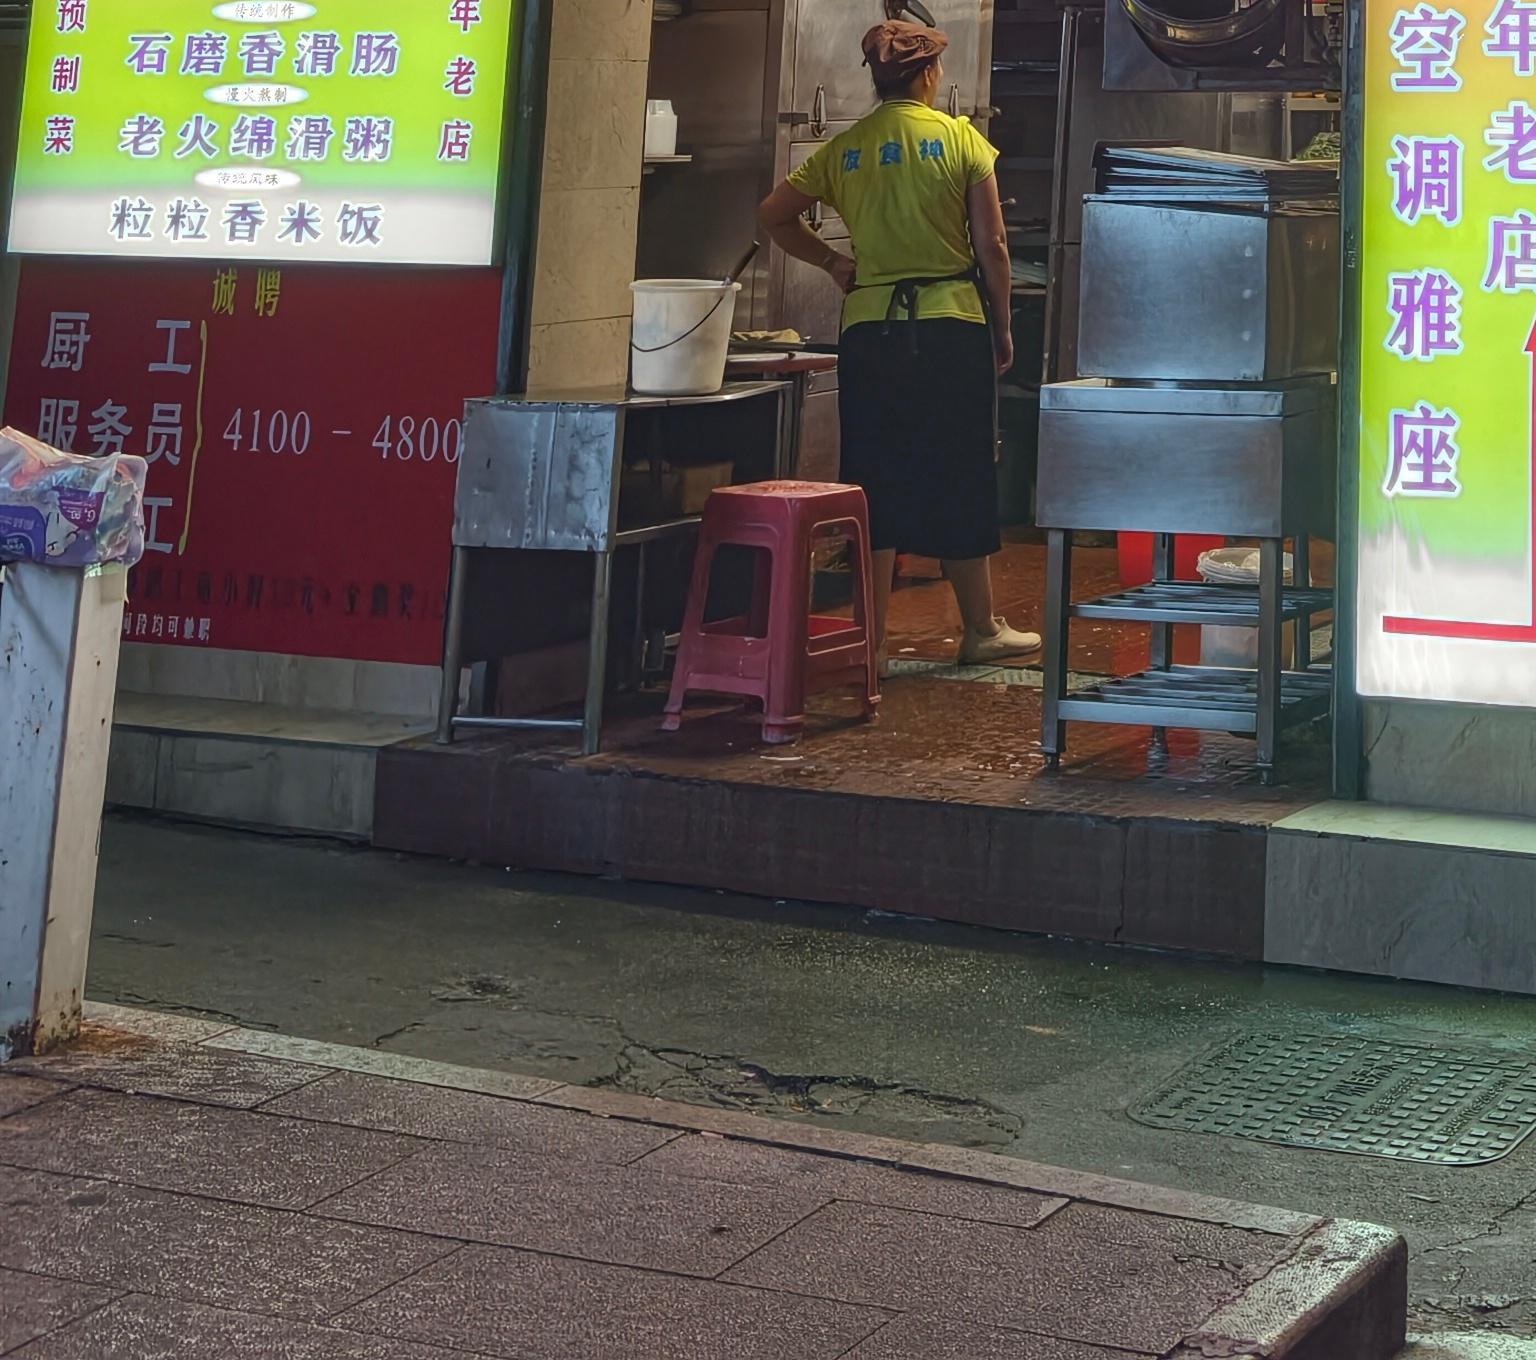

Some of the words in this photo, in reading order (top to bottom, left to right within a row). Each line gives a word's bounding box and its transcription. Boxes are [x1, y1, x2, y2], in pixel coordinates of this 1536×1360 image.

[127, 31, 401, 77] 石磨香滑肠
[119, 114, 393, 162] 老火绵滑粥
[108, 197, 386, 247] 粒粒香米饭
[1385, 3, 1463, 498] 空调雅座
[212, 268, 281, 317] 诚聘
[37, 397, 183, 466] 服务员
[223, 408, 311, 454] 4100
[372, 415, 462, 463] 4800
